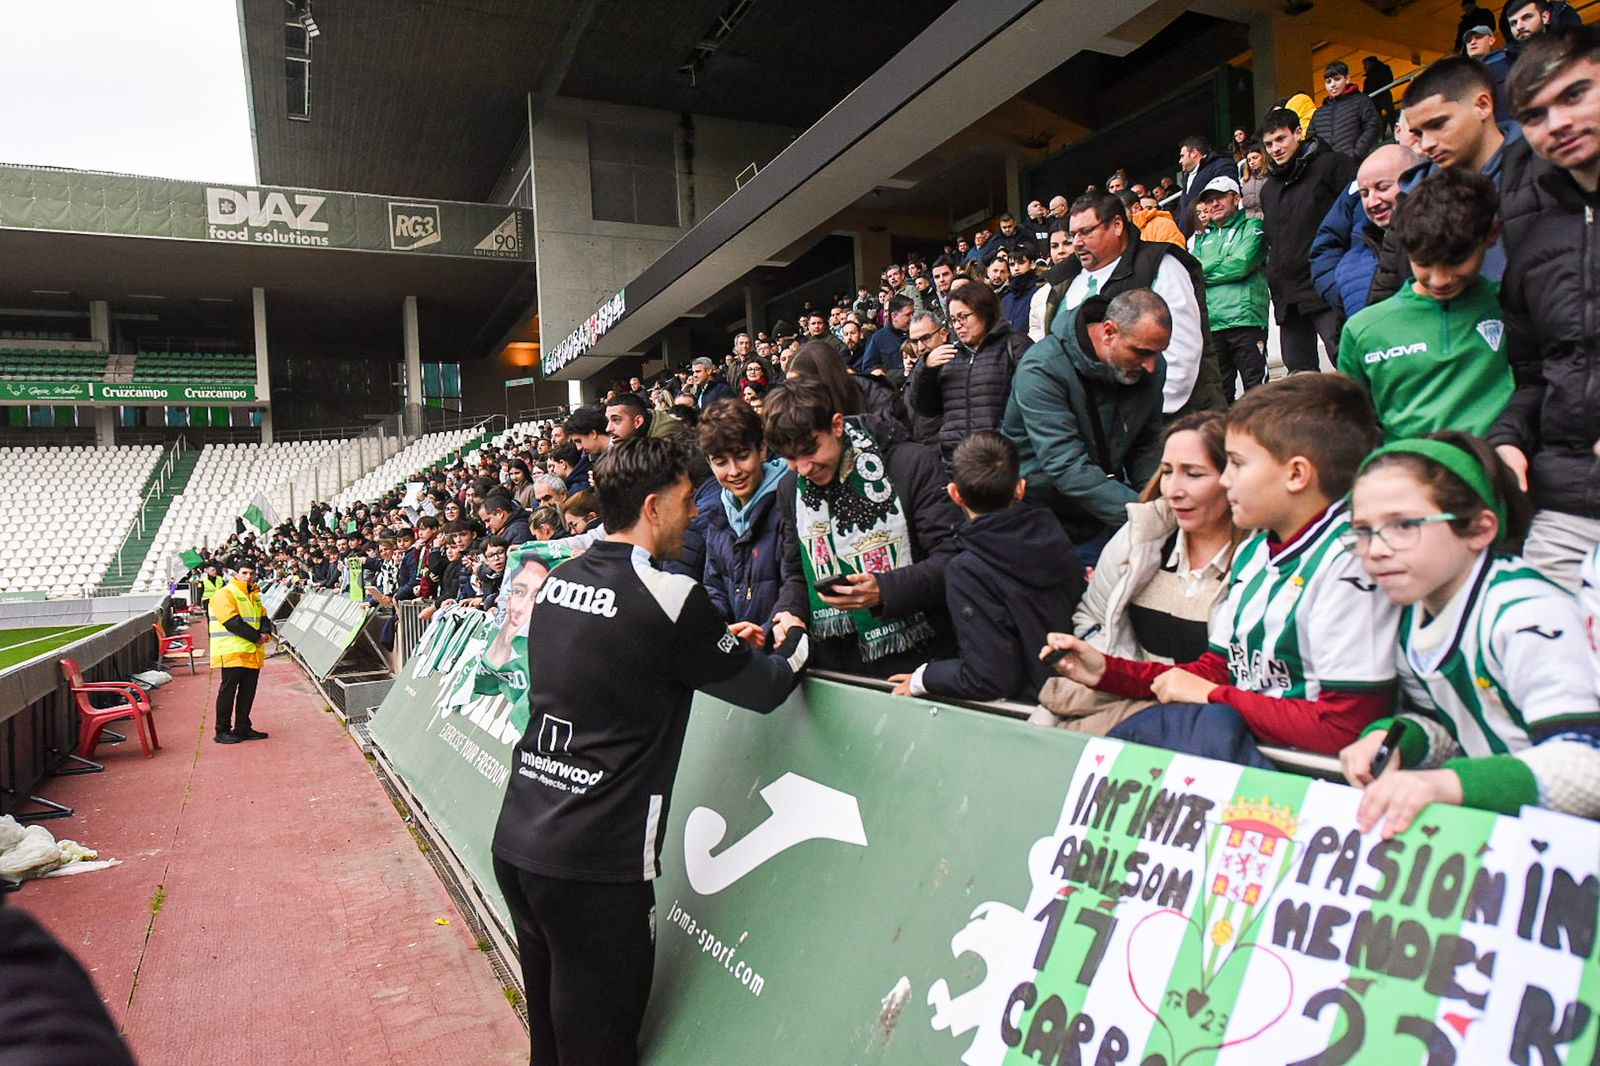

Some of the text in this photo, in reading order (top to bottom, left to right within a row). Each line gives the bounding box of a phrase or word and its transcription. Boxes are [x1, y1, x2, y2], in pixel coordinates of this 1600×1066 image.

[206, 187, 329, 231] DIAZ
[208, 225, 329, 246] food solutions
[396, 214, 434, 238] RG3
[494, 234, 516, 251] 90
[1364, 342, 1428, 364] GIVOVA
[102, 387, 168, 400] Cruzcampo
[184, 388, 247, 400] Cruzcampo
[438, 722, 510, 788] EXERCISE YOUR FREEDOM
[1051, 834, 1195, 914] ADILSON
[667, 900, 764, 996] joma-sport.com
[1034, 899, 1119, 987] 17
